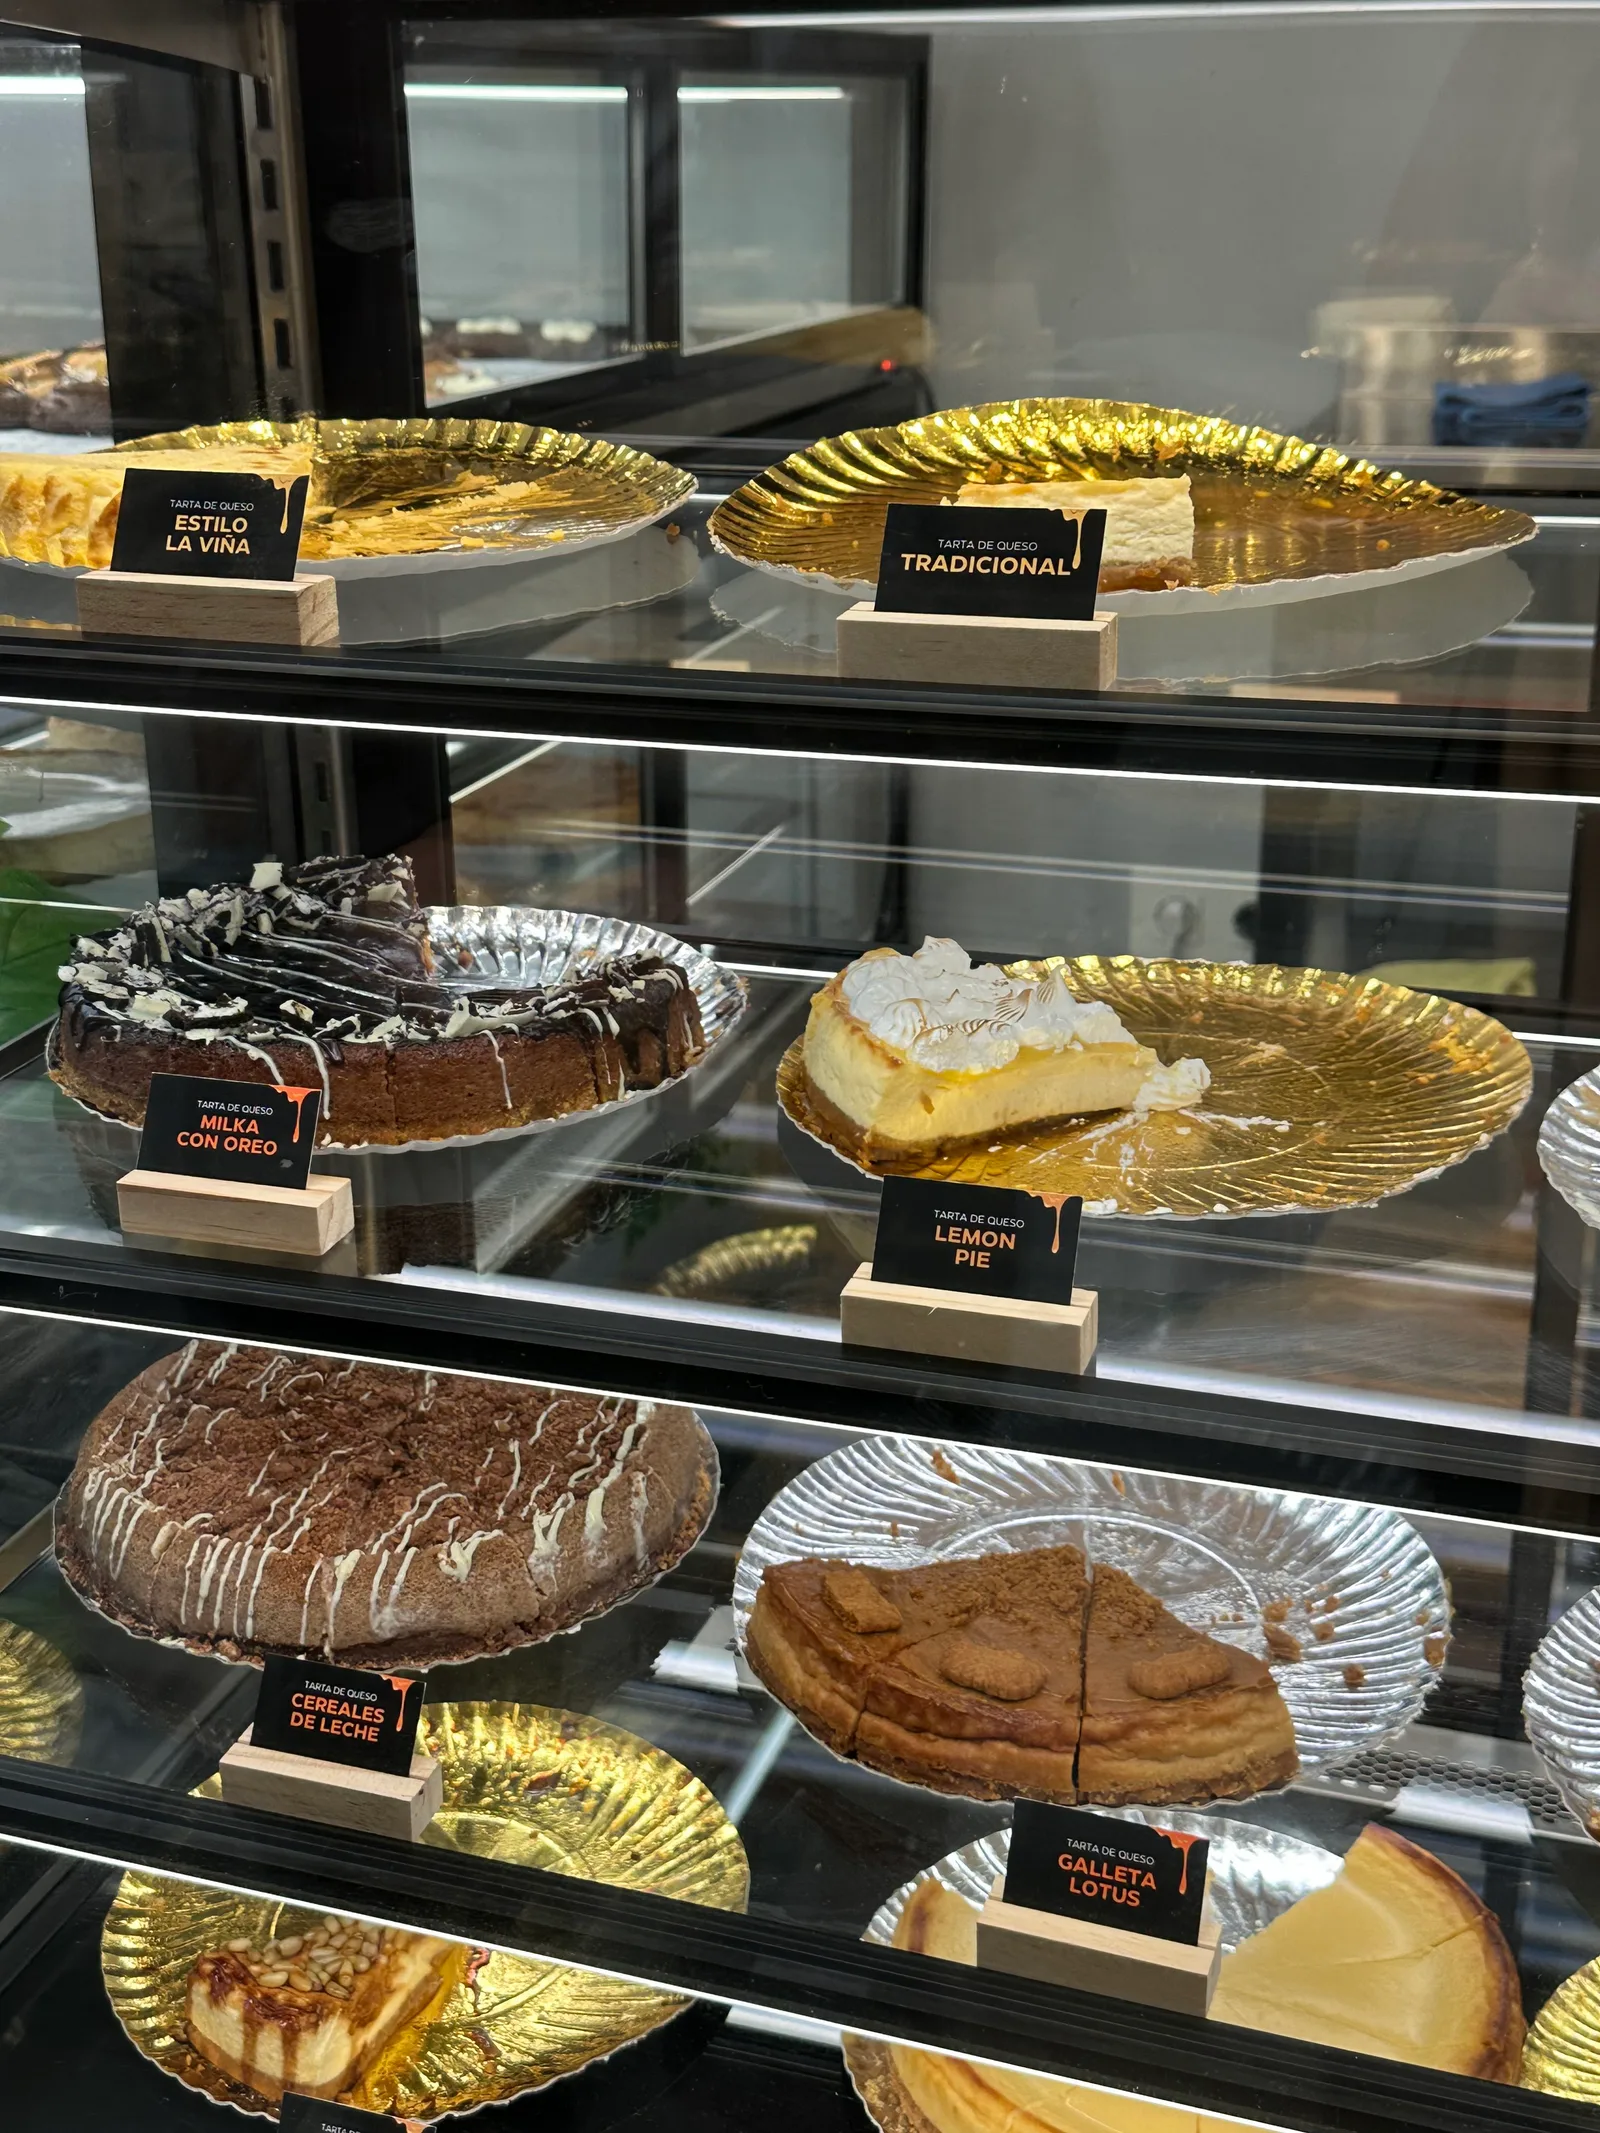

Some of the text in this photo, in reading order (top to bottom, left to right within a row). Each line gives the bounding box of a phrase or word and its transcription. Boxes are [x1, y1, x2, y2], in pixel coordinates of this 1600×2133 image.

[170, 499, 255, 511] TARTA DE QUESO
[174, 514, 248, 534] ESTILO
[165, 534, 251, 555] LA VIÑA
[938, 538, 1038, 551] TARTA DE QUESO
[900, 553, 1071, 576] TRADICIONAL
[197, 1100, 274, 1116] TARTA DE QUESO
[200, 1114, 260, 1135] MILKA
[176, 1131, 278, 1156] CON OREO
[934, 1209, 1025, 1229] TARTA DE QUESO
[934, 1224, 1016, 1250] LEMON
[954, 1248, 991, 1269] PIE
[304, 1680, 378, 1702] TARTA DE QUESO
[291, 1692, 386, 1724] CEREALES
[290, 1711, 380, 1743] DE LECHE
[1066, 1838, 1155, 1866] TARTA DE QUESO
[1058, 1853, 1157, 1891] GALLETA
[1069, 1876, 1140, 1908] LOTUS
